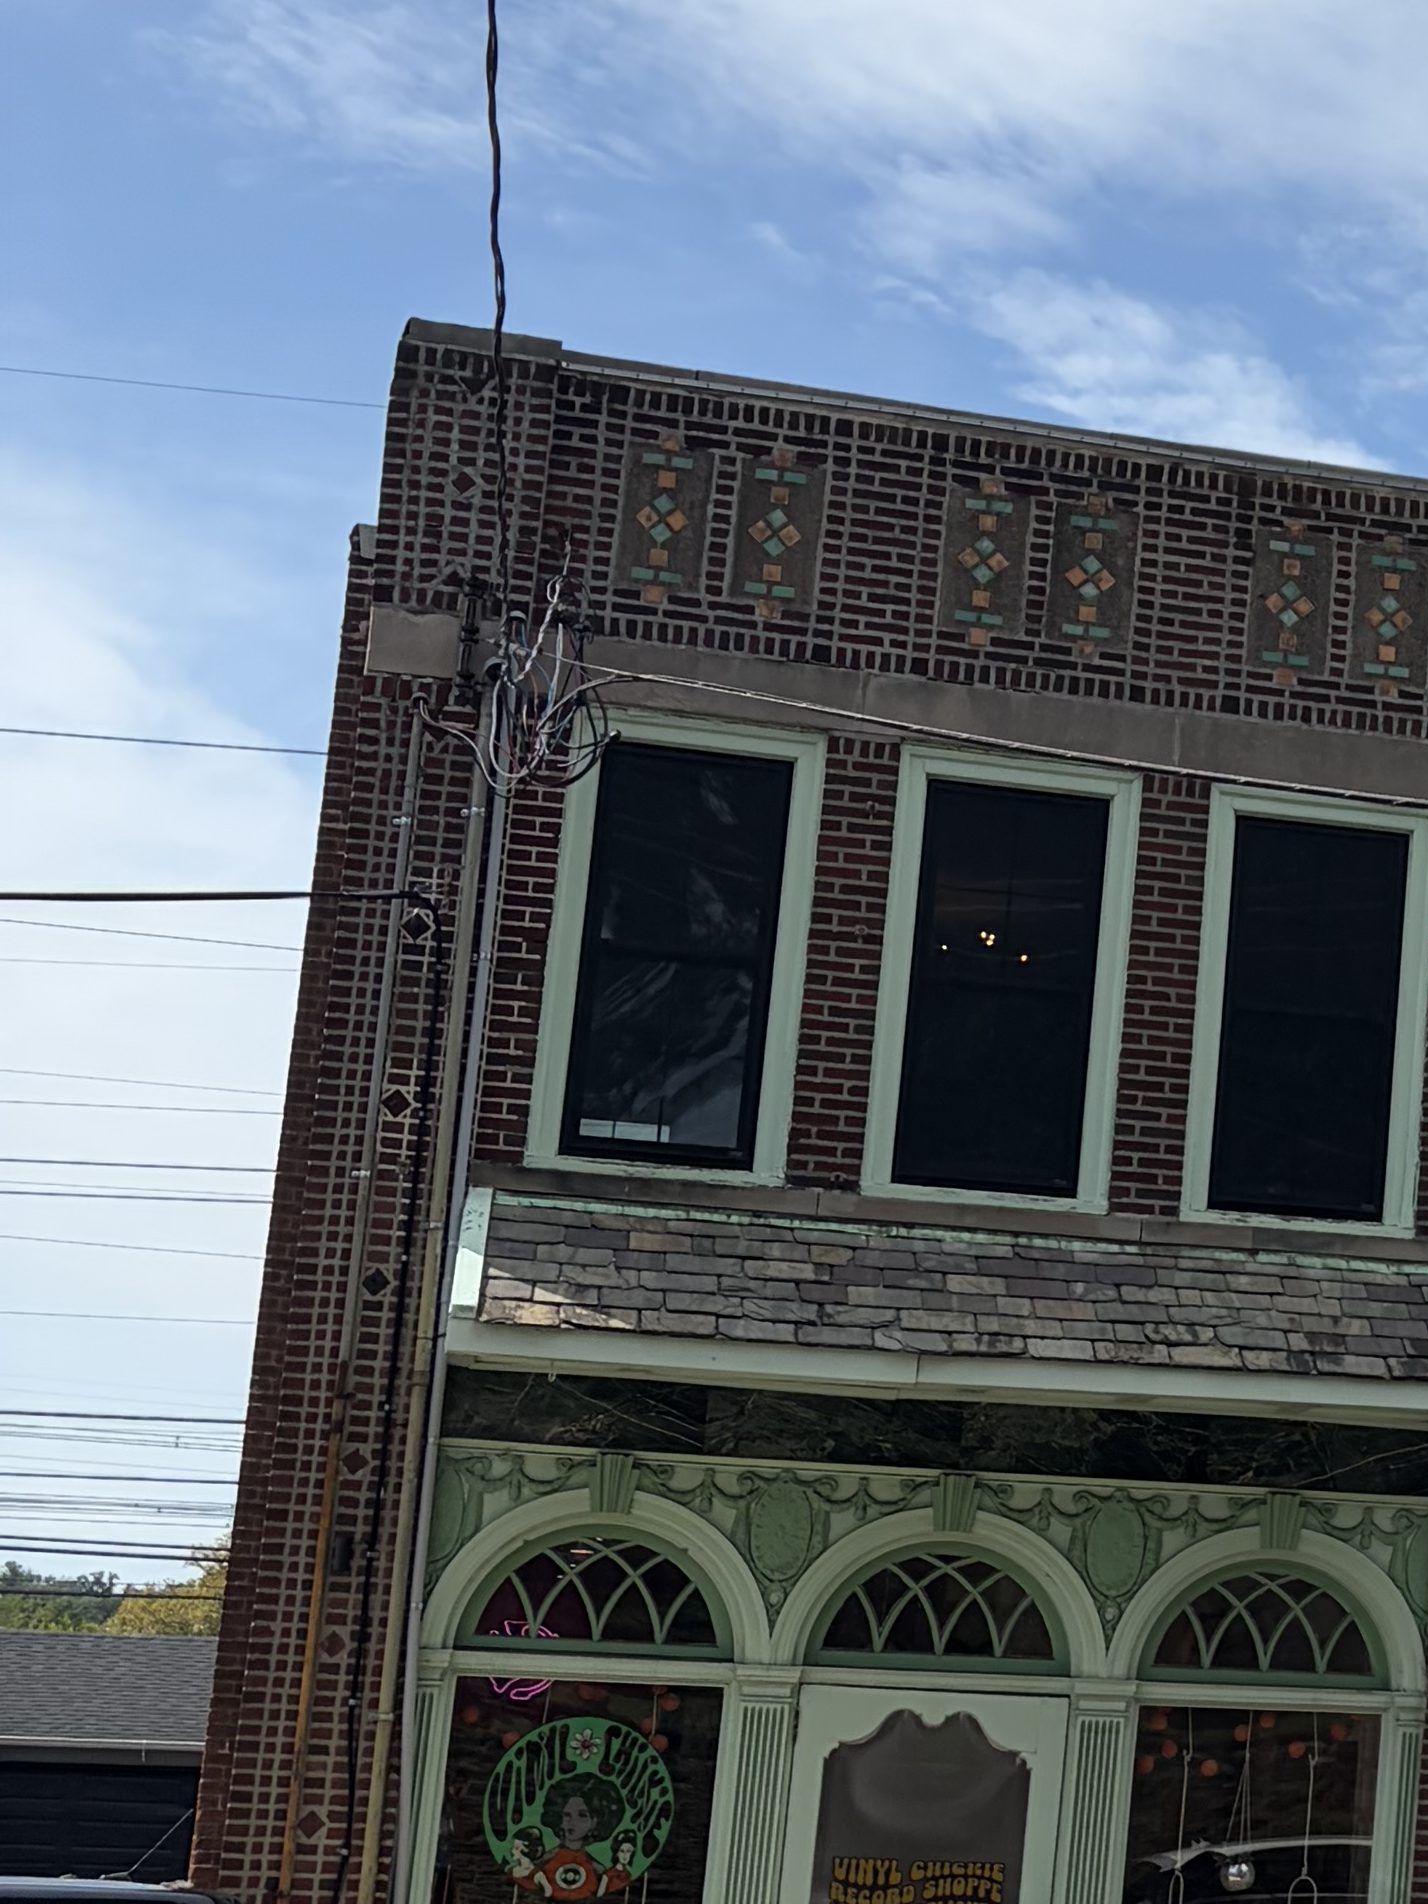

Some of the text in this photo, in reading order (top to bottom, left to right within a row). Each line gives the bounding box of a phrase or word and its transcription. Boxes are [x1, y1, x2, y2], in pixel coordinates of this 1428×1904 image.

[832, 1856, 1006, 1887] VINYL CHICKIE
[922, 1876, 1003, 1903] SHOPPE
